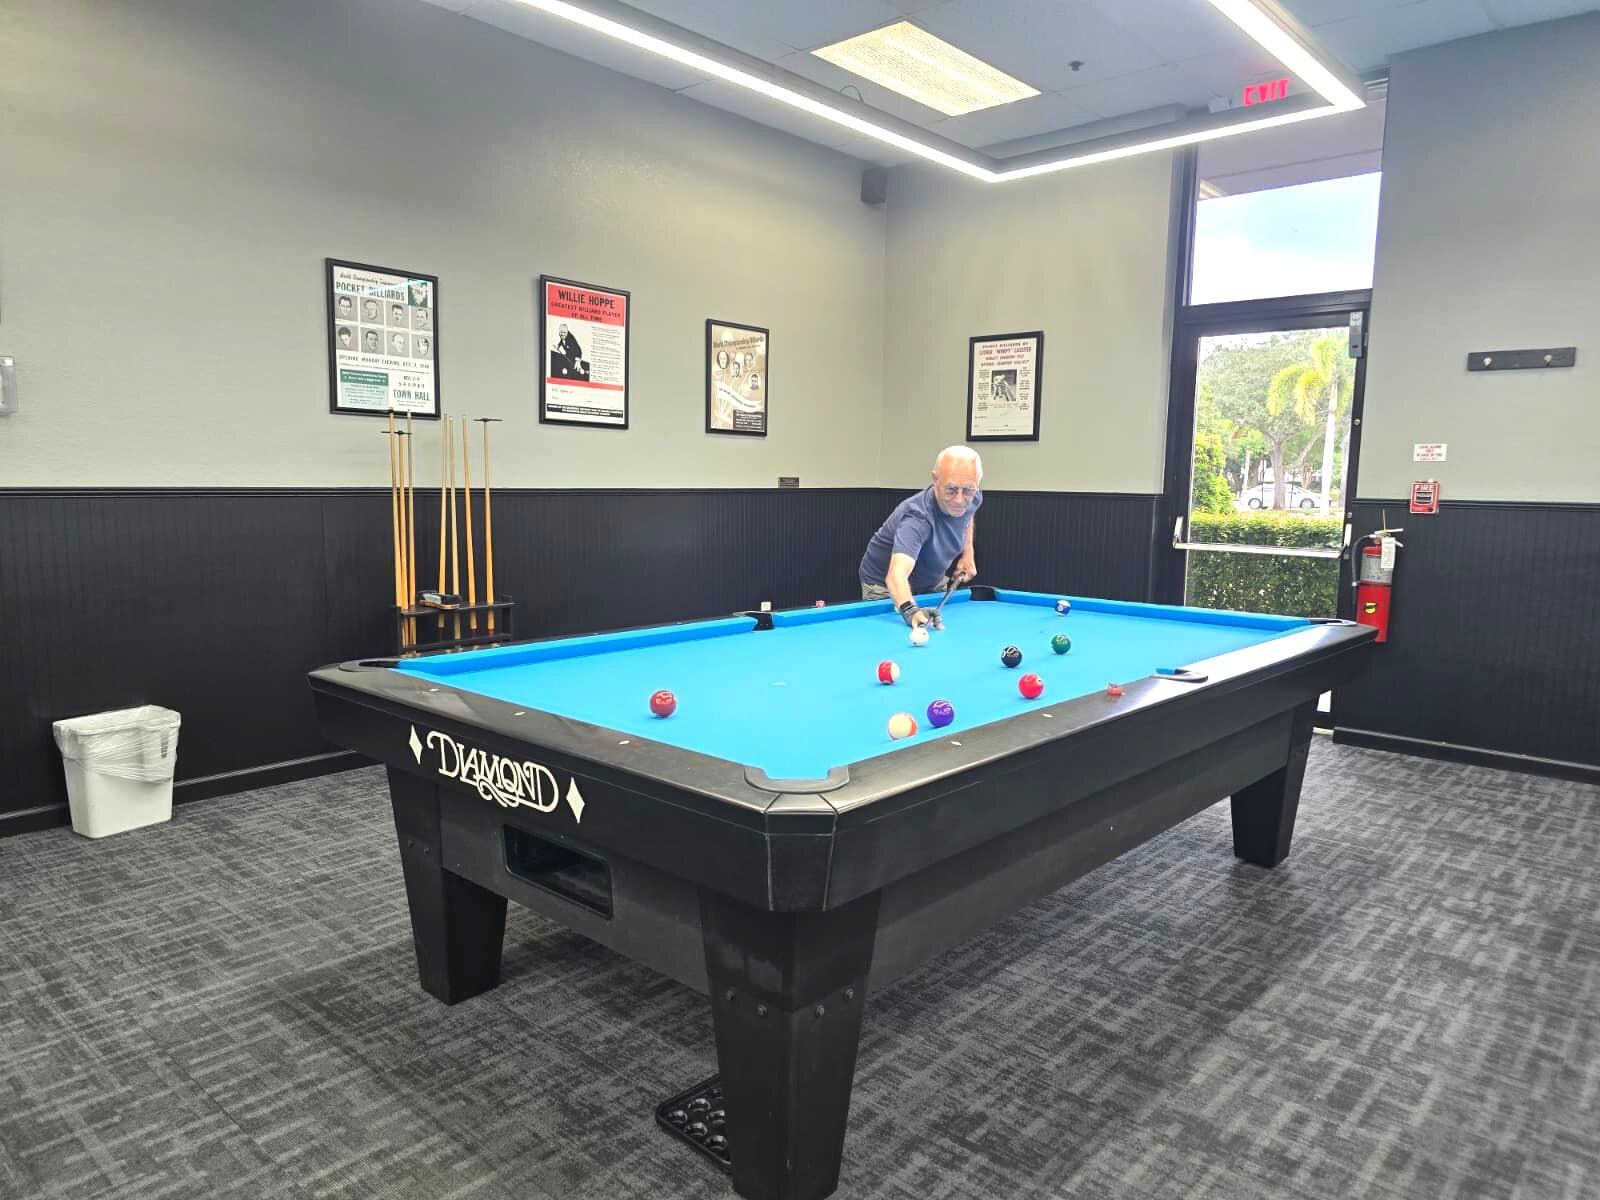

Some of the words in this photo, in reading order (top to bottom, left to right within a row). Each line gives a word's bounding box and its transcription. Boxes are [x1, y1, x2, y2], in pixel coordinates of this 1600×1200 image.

[1243, 79, 1289, 107] EXIT
[336, 281, 365, 293] POCKET
[368, 286, 405, 300] BILLIARDS
[558, 290, 585, 304] WILLIE
[589, 295, 615, 309] HOPPE
[393, 389, 412, 399] TOWN
[414, 391, 431, 401] HALL
[427, 730, 559, 813] DIAMOND
